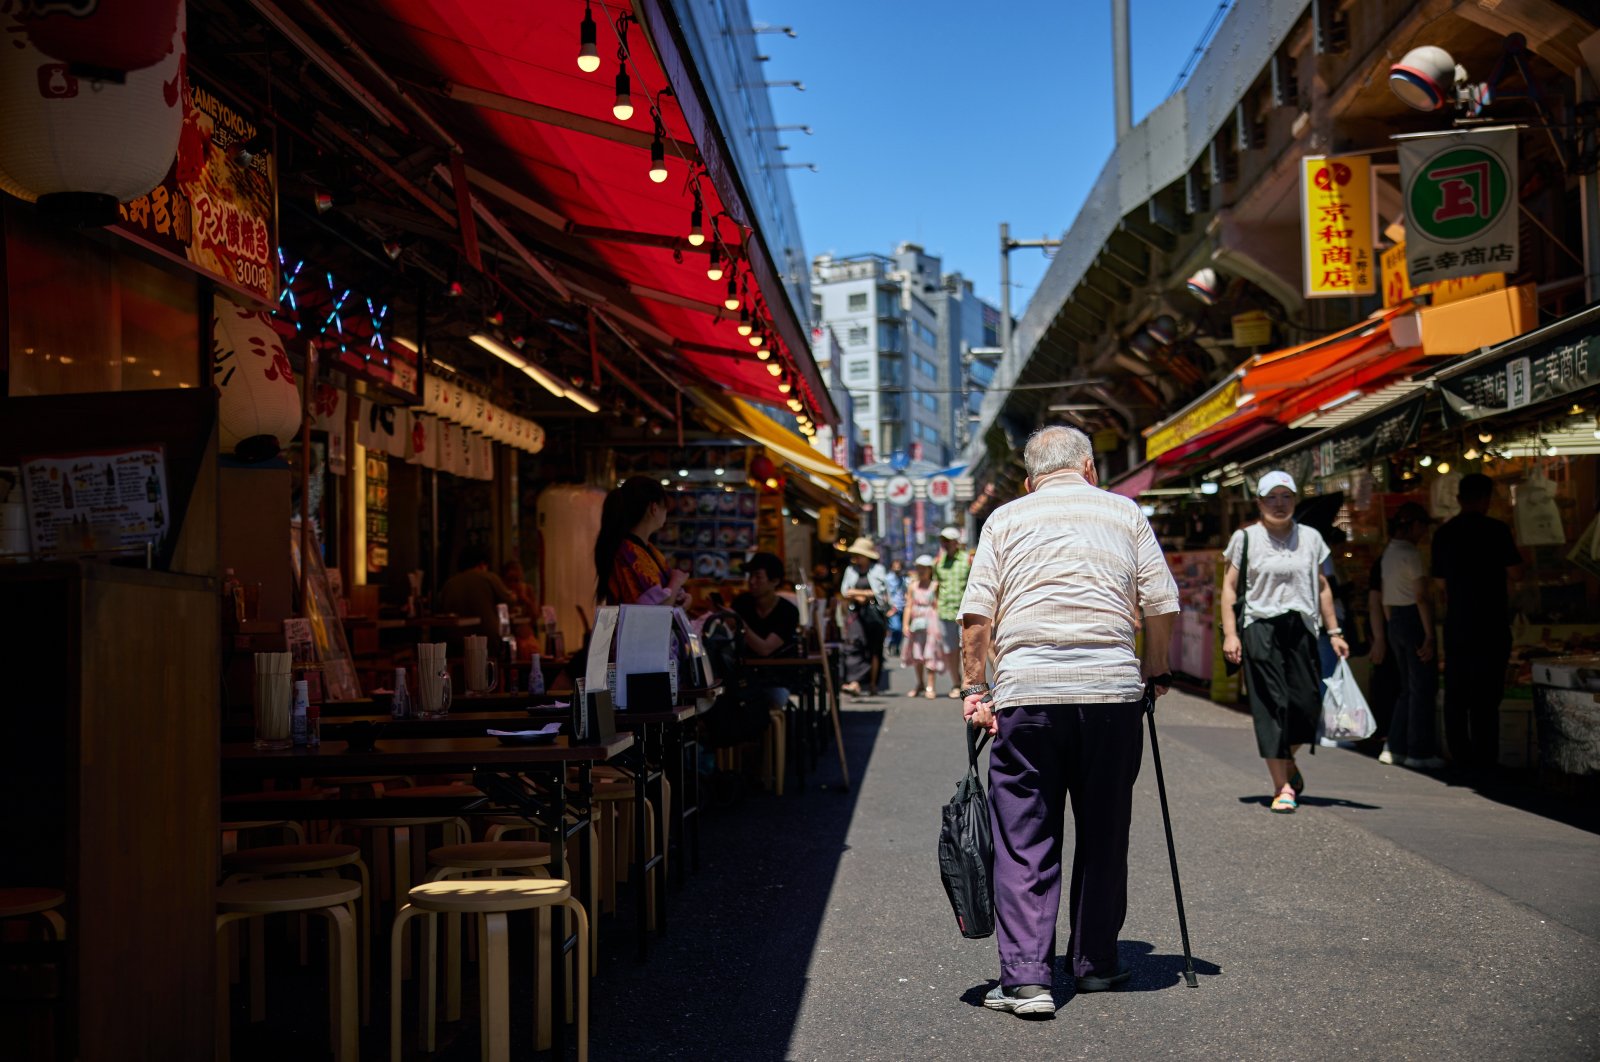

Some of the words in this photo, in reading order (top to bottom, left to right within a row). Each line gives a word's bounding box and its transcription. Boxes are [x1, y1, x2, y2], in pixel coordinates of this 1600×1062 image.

[196, 195, 269, 263] アメ横焼き
[1317, 203, 1353, 287] 京和商店
[237, 259, 267, 291] 300円
[1412, 244, 1514, 275] 三幸商店
[1533, 339, 1588, 389] 三幸商店
